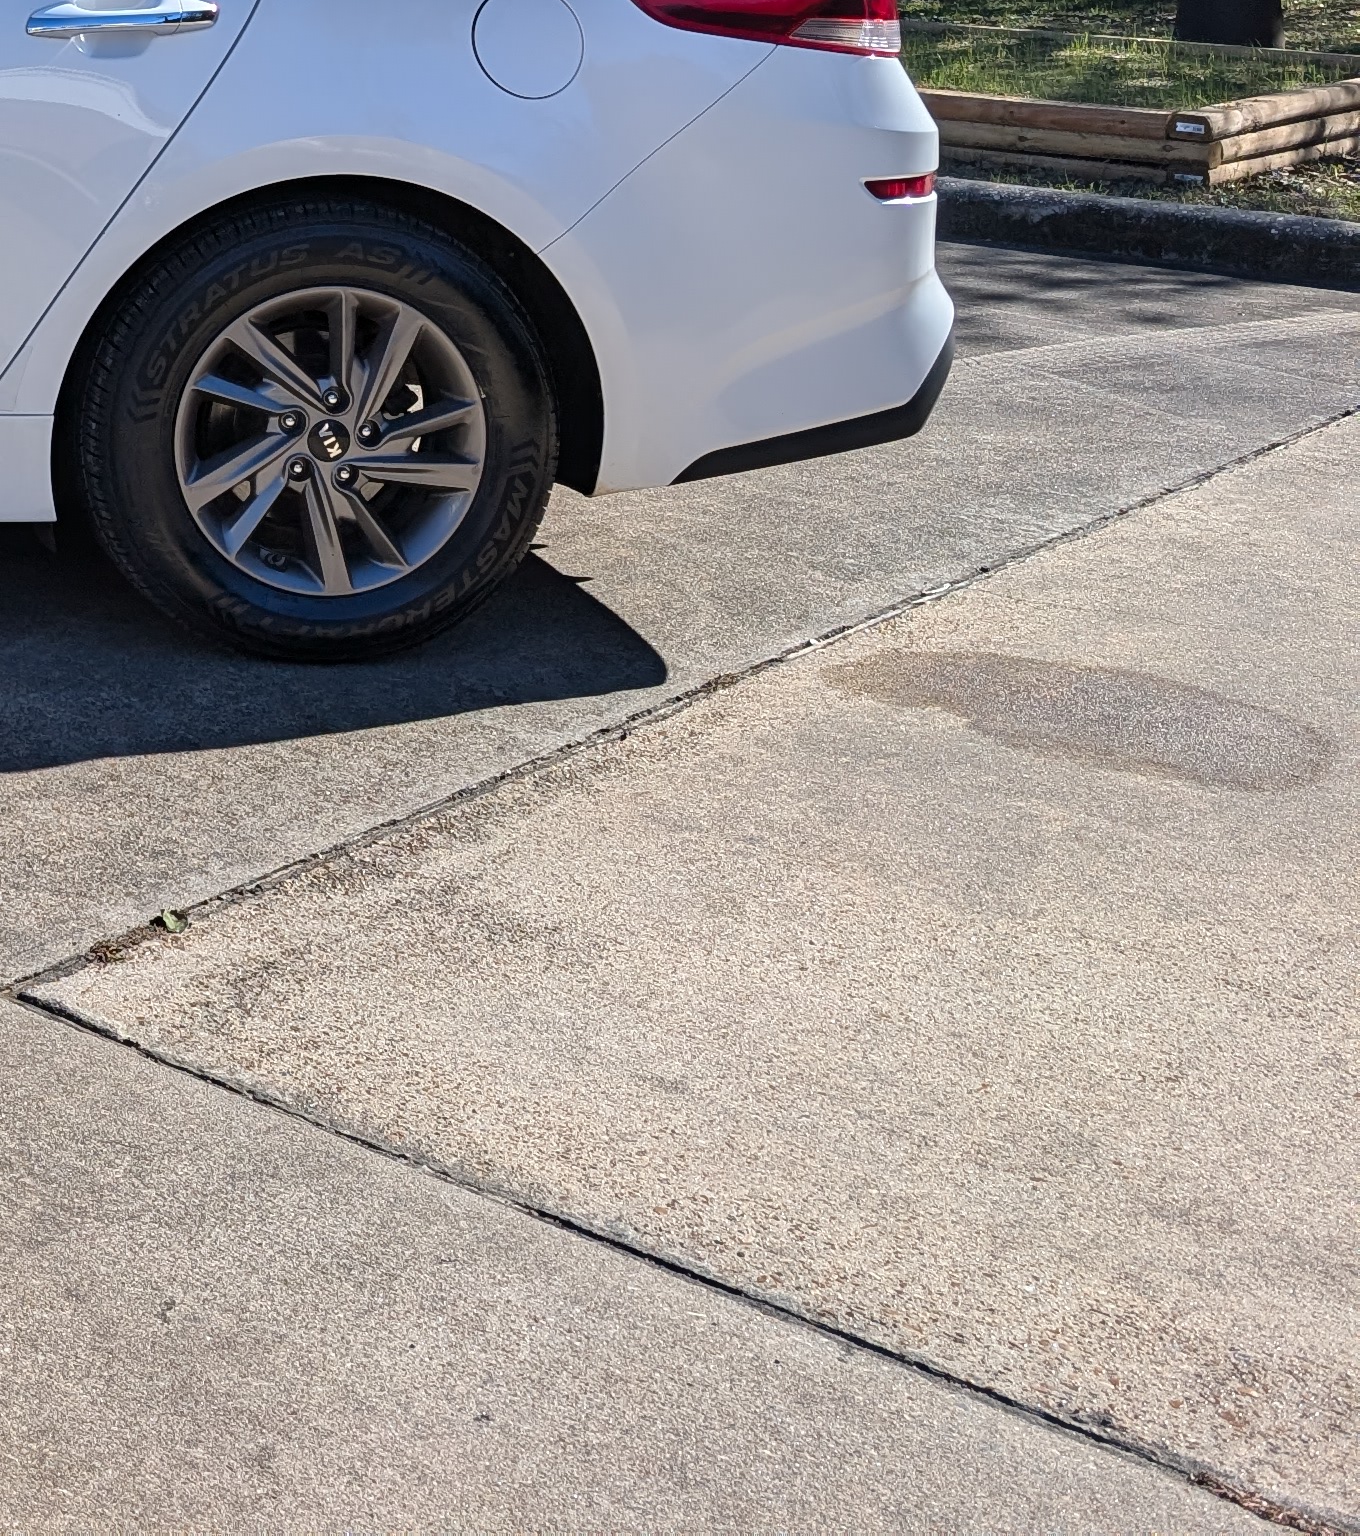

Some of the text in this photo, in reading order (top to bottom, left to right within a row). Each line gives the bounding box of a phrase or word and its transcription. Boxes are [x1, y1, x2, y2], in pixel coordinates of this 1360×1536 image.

[145, 242, 402, 385] STRATUS AS
[318, 422, 343, 459] KIA
